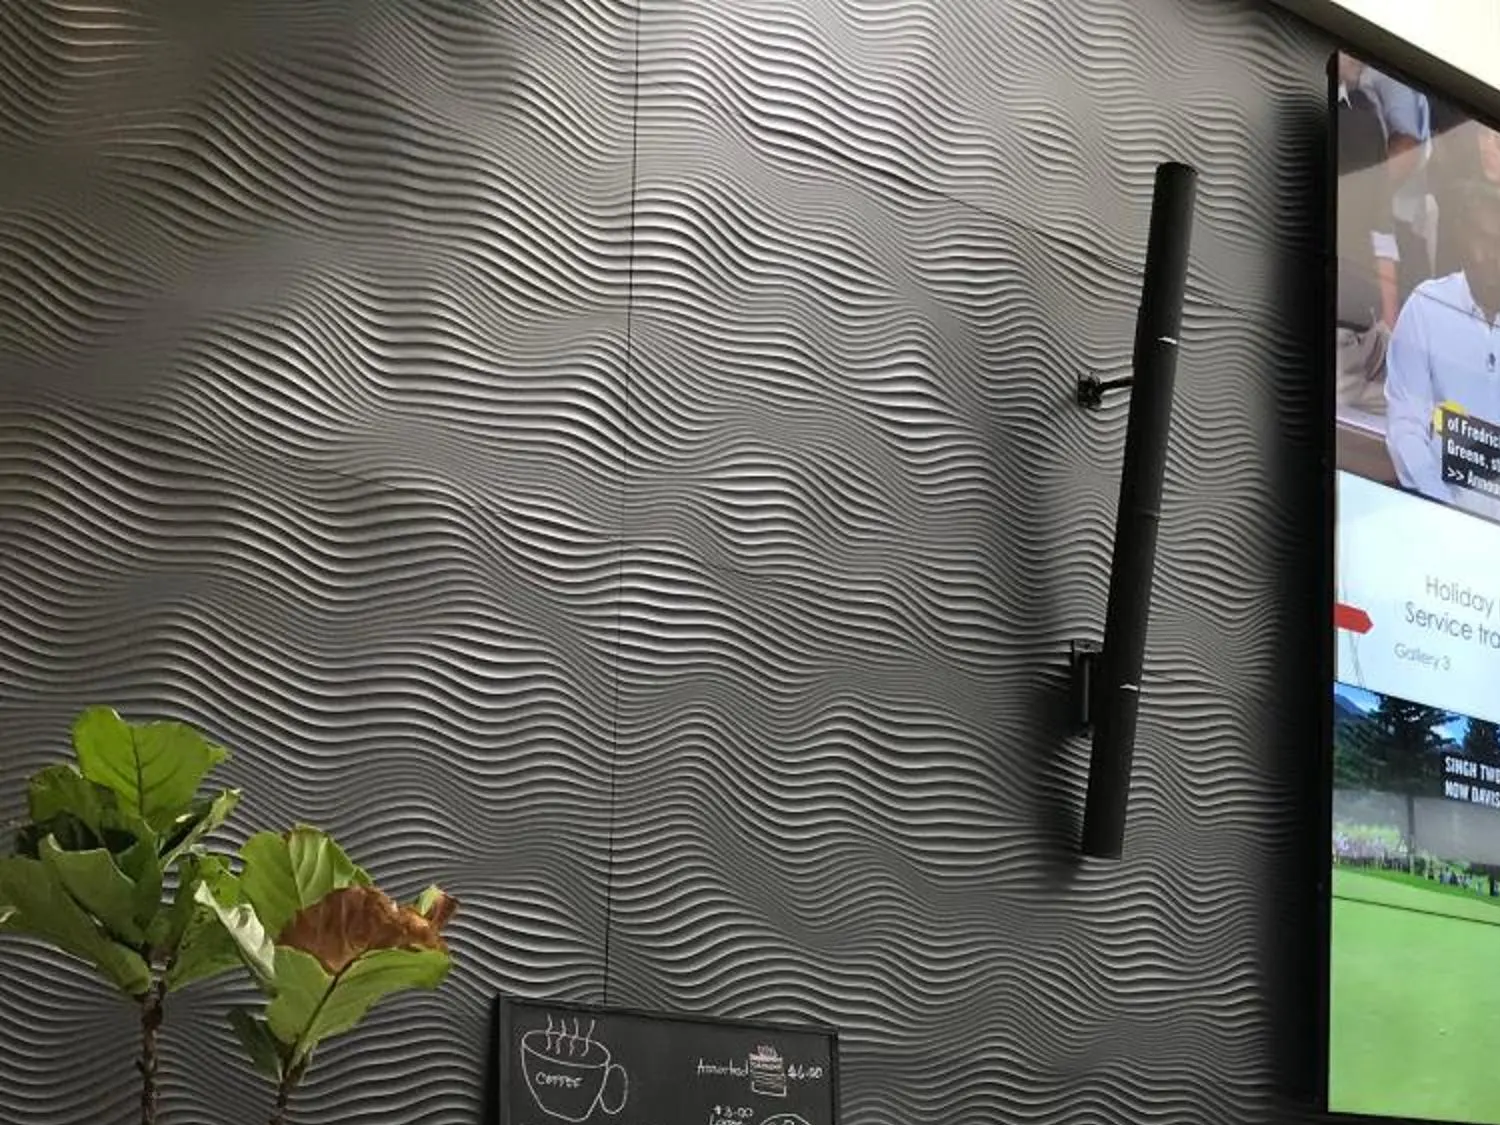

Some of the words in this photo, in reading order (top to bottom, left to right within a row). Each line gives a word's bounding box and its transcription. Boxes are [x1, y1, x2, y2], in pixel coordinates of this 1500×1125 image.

[1448, 417, 1458, 431] of
[1425, 575, 1494, 620] Holiday
[1405, 601, 1472, 640] Service
[1394, 643, 1439, 669] Gallery
[1445, 756, 1477, 778] SINGH
[1445, 781, 1470, 800] NOW
[1471, 787, 1500, 808] DAVIS
